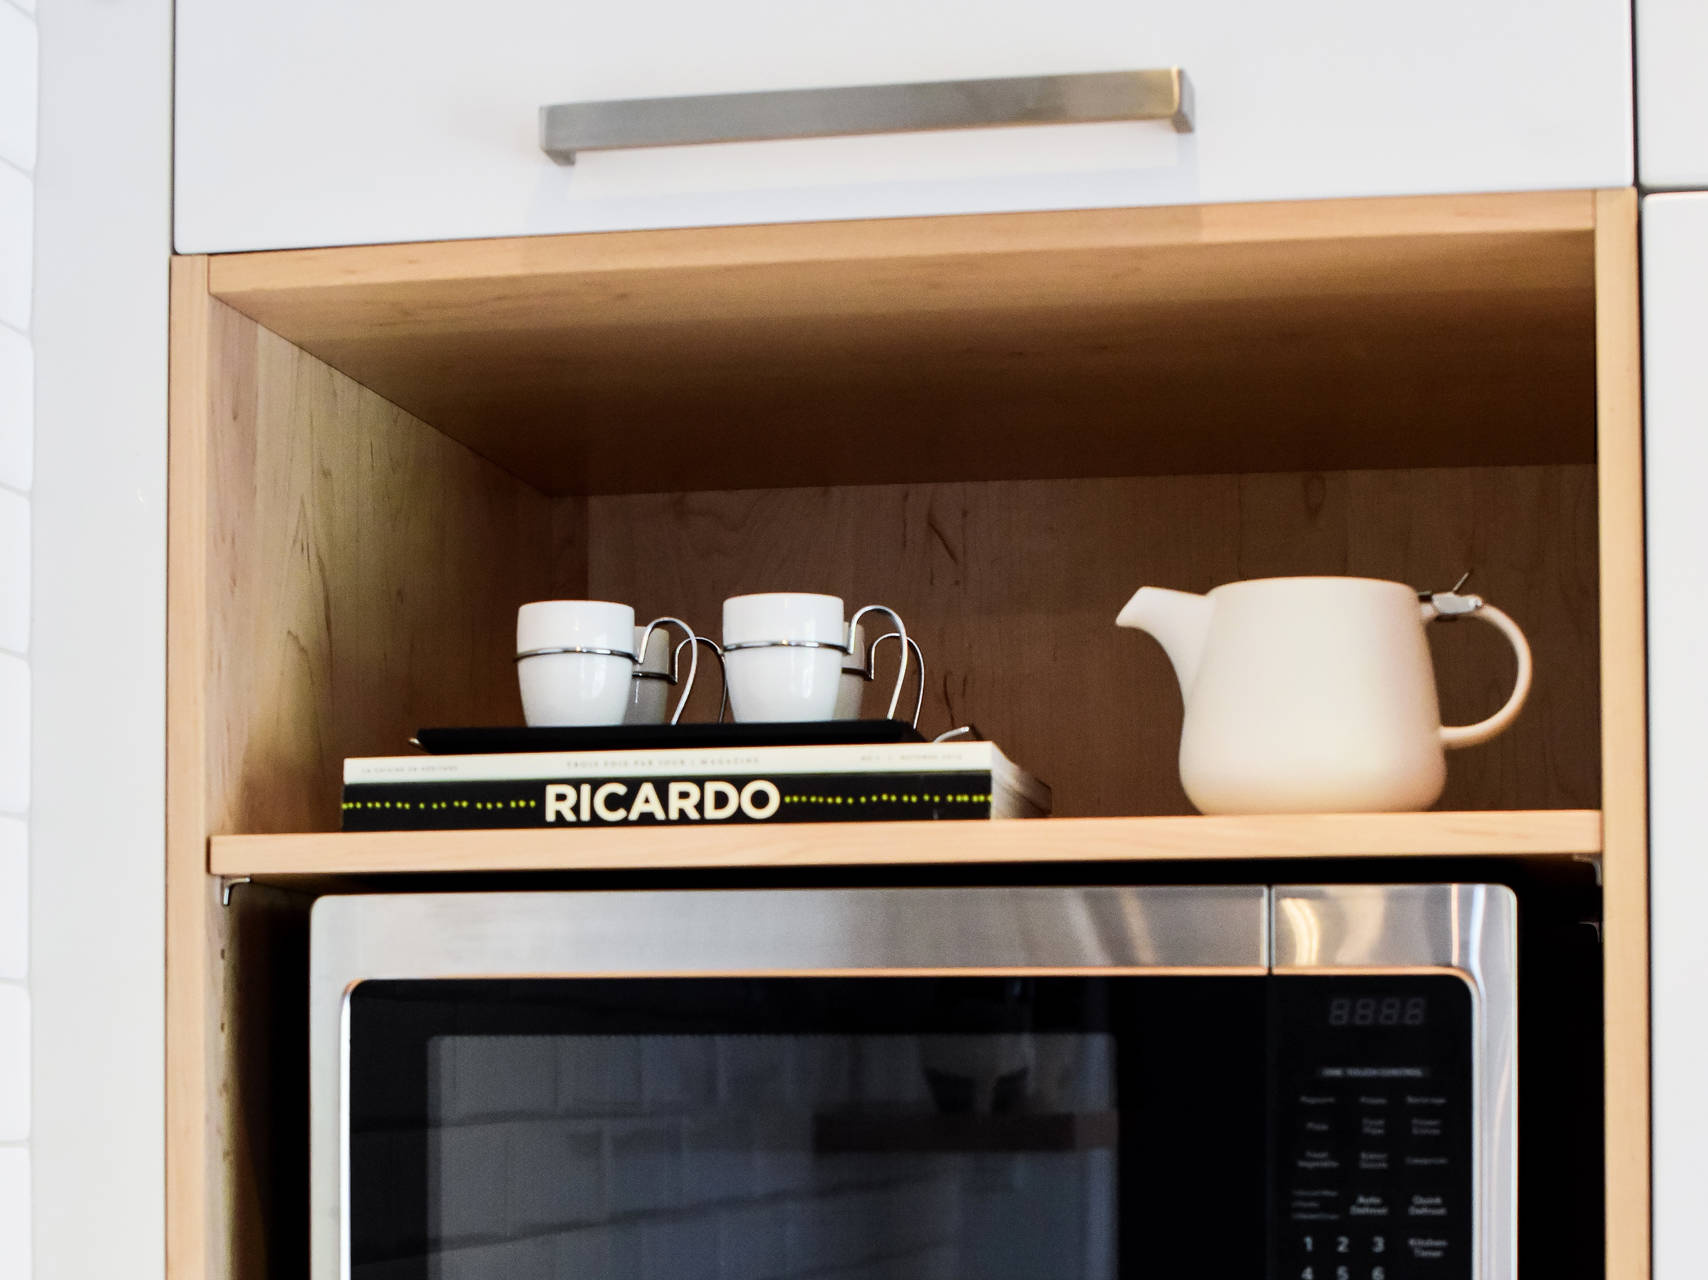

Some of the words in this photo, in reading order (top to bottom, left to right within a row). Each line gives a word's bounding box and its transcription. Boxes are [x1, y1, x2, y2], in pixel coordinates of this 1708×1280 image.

[545, 780, 781, 822] RICARDO
[1303, 1236, 1313, 1252] 1
[1336, 1236, 1350, 1252] 2
[1372, 1236, 1386, 1252] 3
